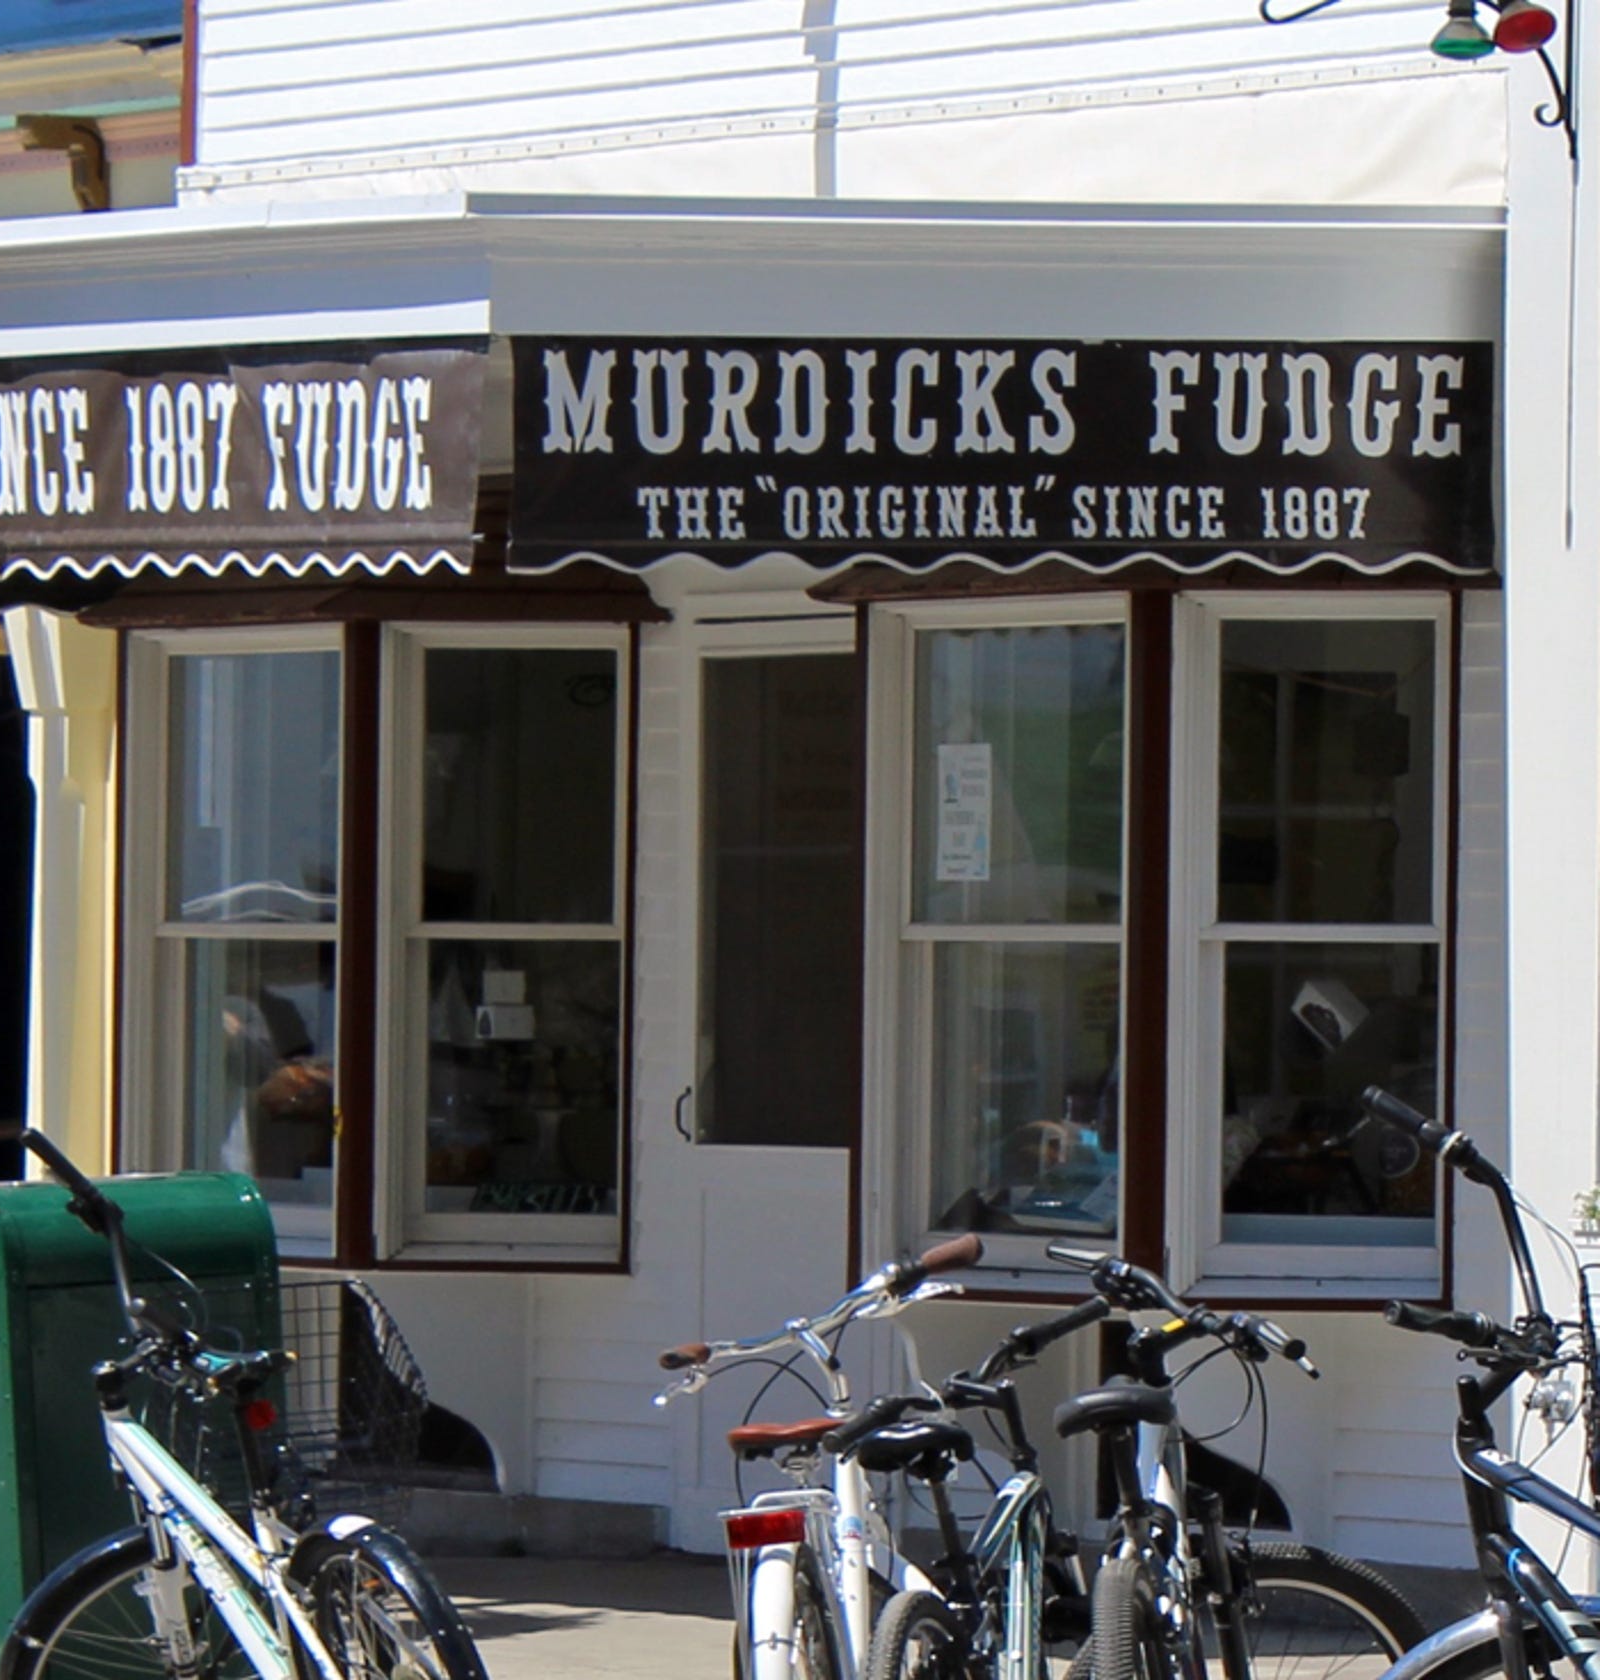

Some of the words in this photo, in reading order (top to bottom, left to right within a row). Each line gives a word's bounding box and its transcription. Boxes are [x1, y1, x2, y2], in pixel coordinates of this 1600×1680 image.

[126, 382, 237, 513] 1887
[263, 376, 431, 512] FUDGE
[542, 348, 1079, 455] MURDICKS
[1148, 350, 1464, 458] FUDGE
[637, 487, 747, 539] THE
[1072, 488, 1226, 539] SINCE
[1261, 487, 1372, 539] 1887
